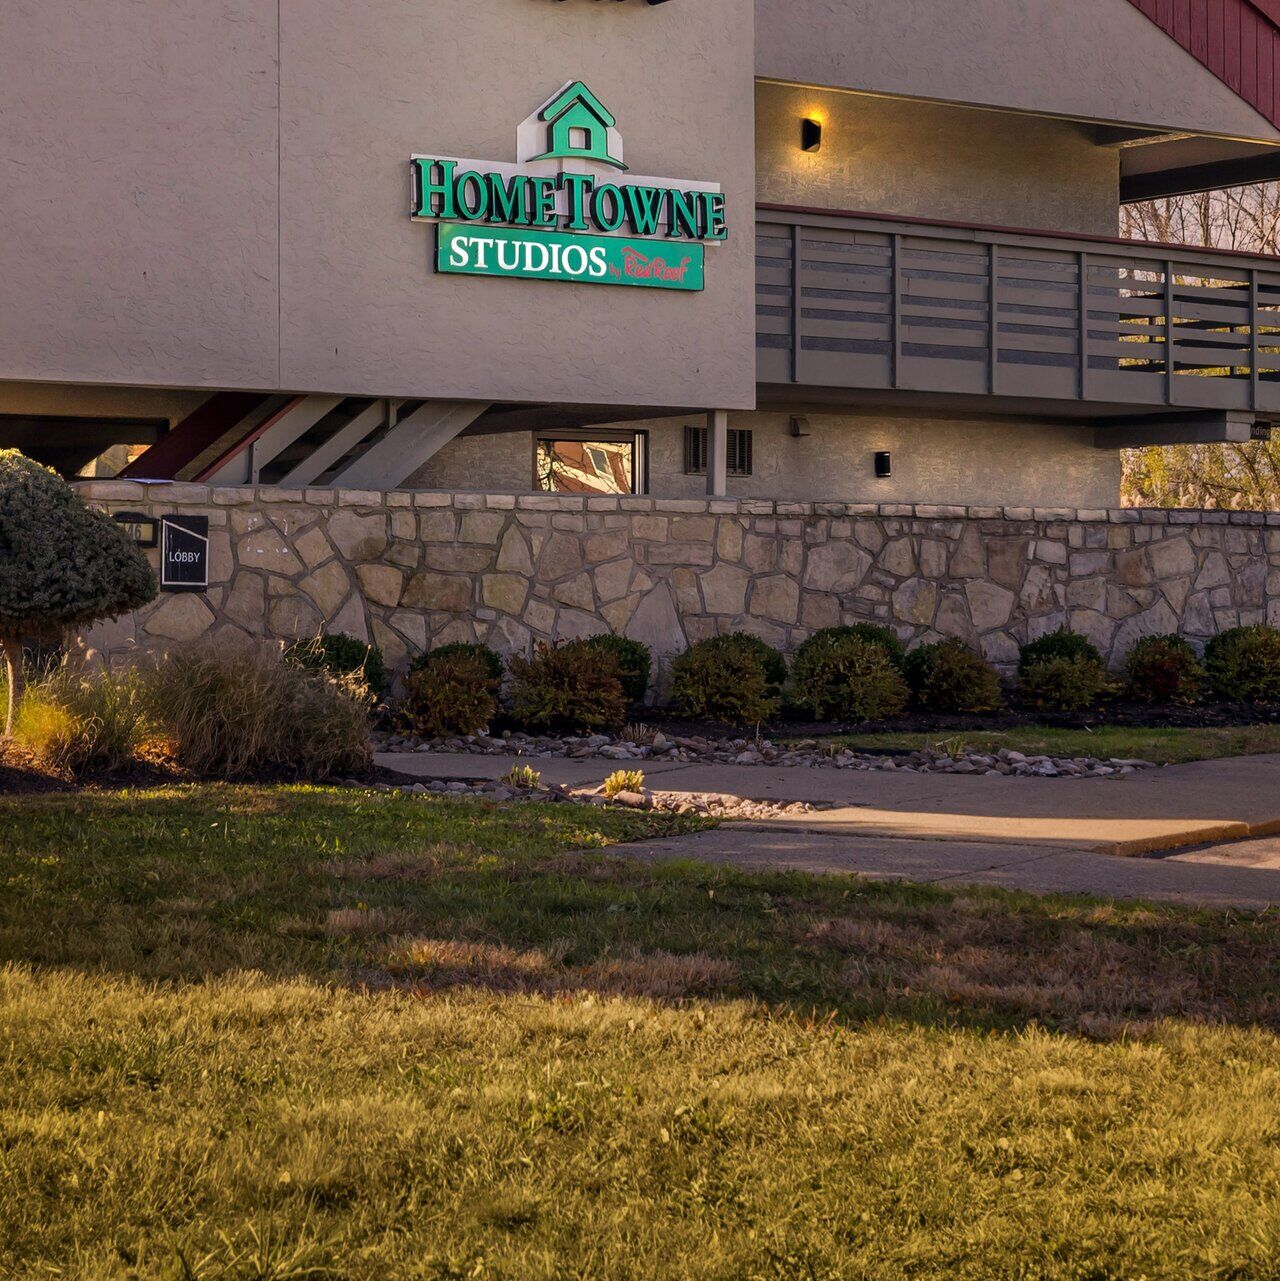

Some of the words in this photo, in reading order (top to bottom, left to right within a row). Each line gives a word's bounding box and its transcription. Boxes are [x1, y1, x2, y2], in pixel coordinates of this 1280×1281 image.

[449, 235, 607, 277] STUDIOS
[625, 255, 653, 279] Red
[653, 256, 691, 283] Roof
[169, 551, 201, 563] LOBBY
